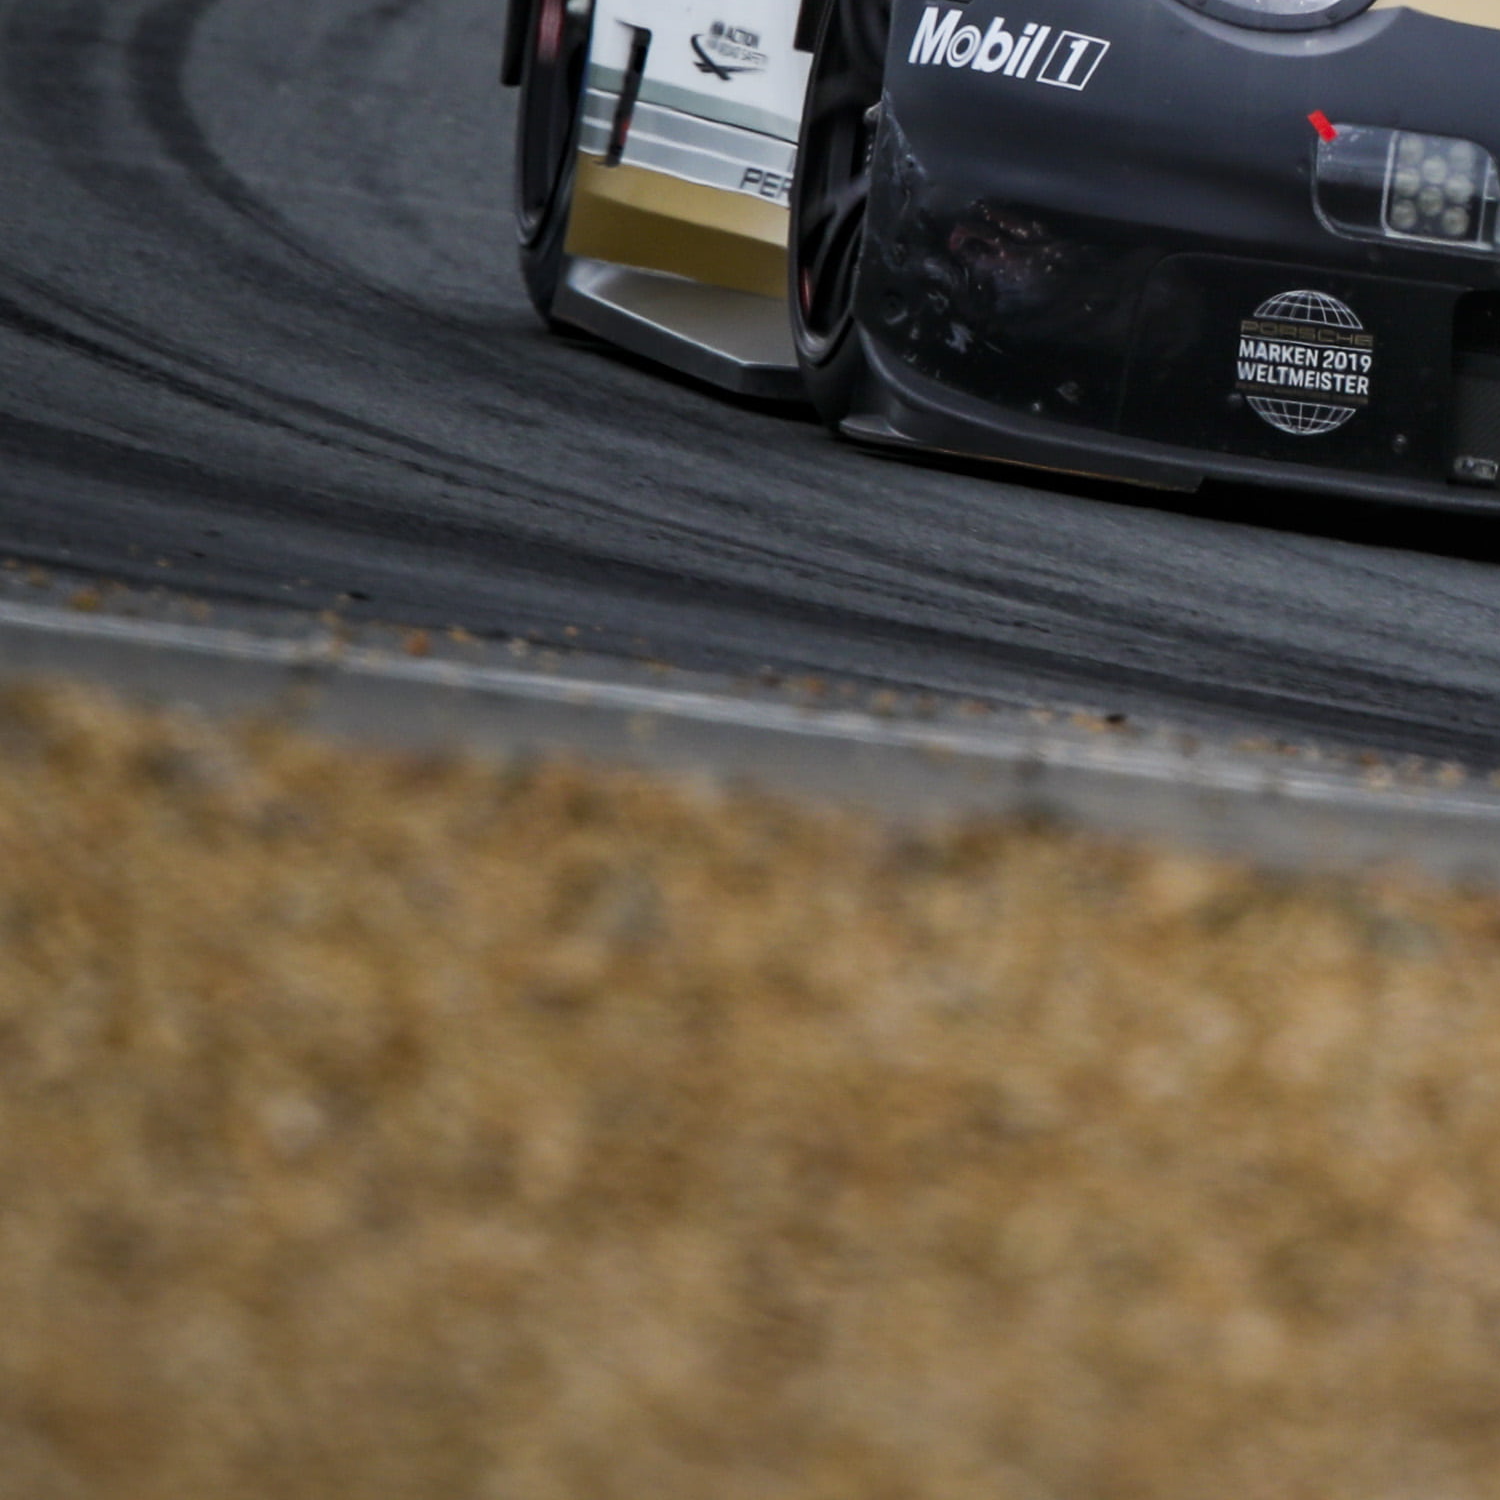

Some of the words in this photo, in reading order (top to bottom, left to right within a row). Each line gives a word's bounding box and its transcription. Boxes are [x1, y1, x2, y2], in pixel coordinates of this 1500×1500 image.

[907, 6, 1052, 80] Mobil
[1241, 319, 1375, 347] PORSCHE
[1238, 338, 1319, 368] MARKEN
[1321, 348, 1373, 373] 2019
[1236, 360, 1370, 395] WELTMEISTER
